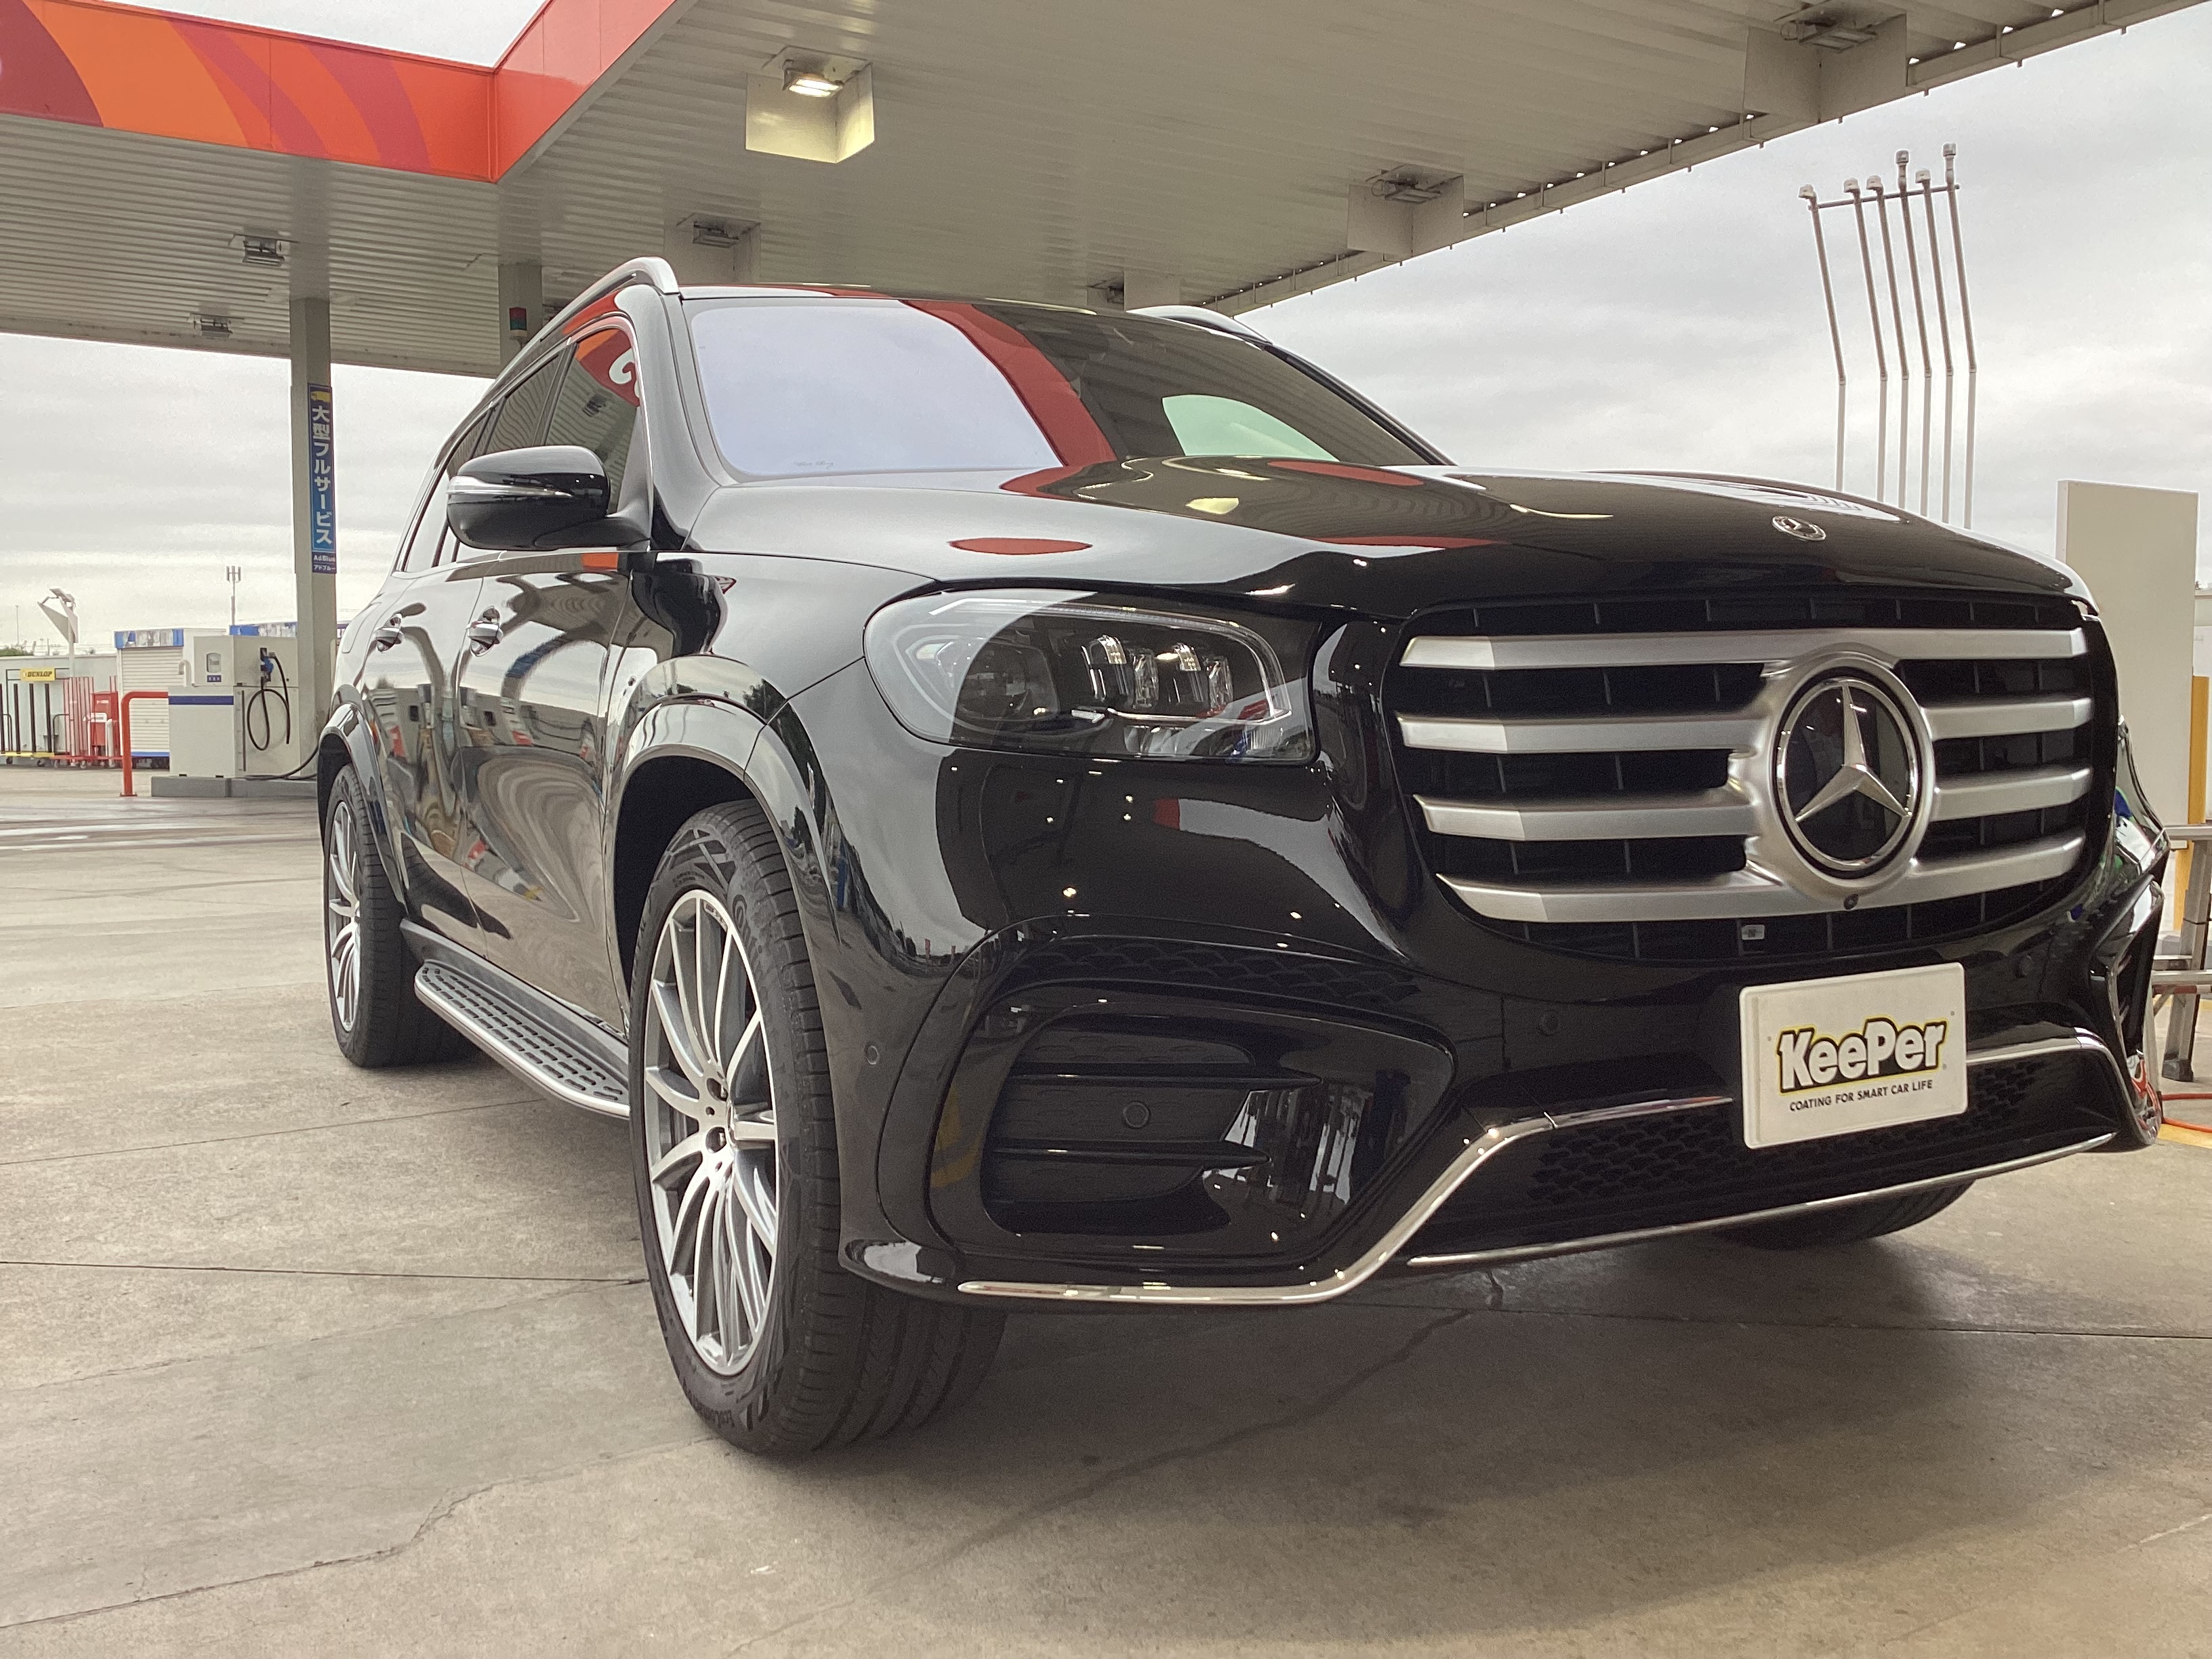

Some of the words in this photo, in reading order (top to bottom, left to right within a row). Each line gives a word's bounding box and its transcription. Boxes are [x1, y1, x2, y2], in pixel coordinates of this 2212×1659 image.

[312, 405, 332, 546] 大型フルサービス
[1777, 1017, 1946, 1093] KeePer
[1790, 1096, 1832, 1112] COATING
[1835, 1092, 1854, 1104] FOR
[1857, 1086, 1888, 1101] SMART
[1891, 1082, 1910, 1094] CAR
[1912, 1079, 1933, 1092] LIFE
